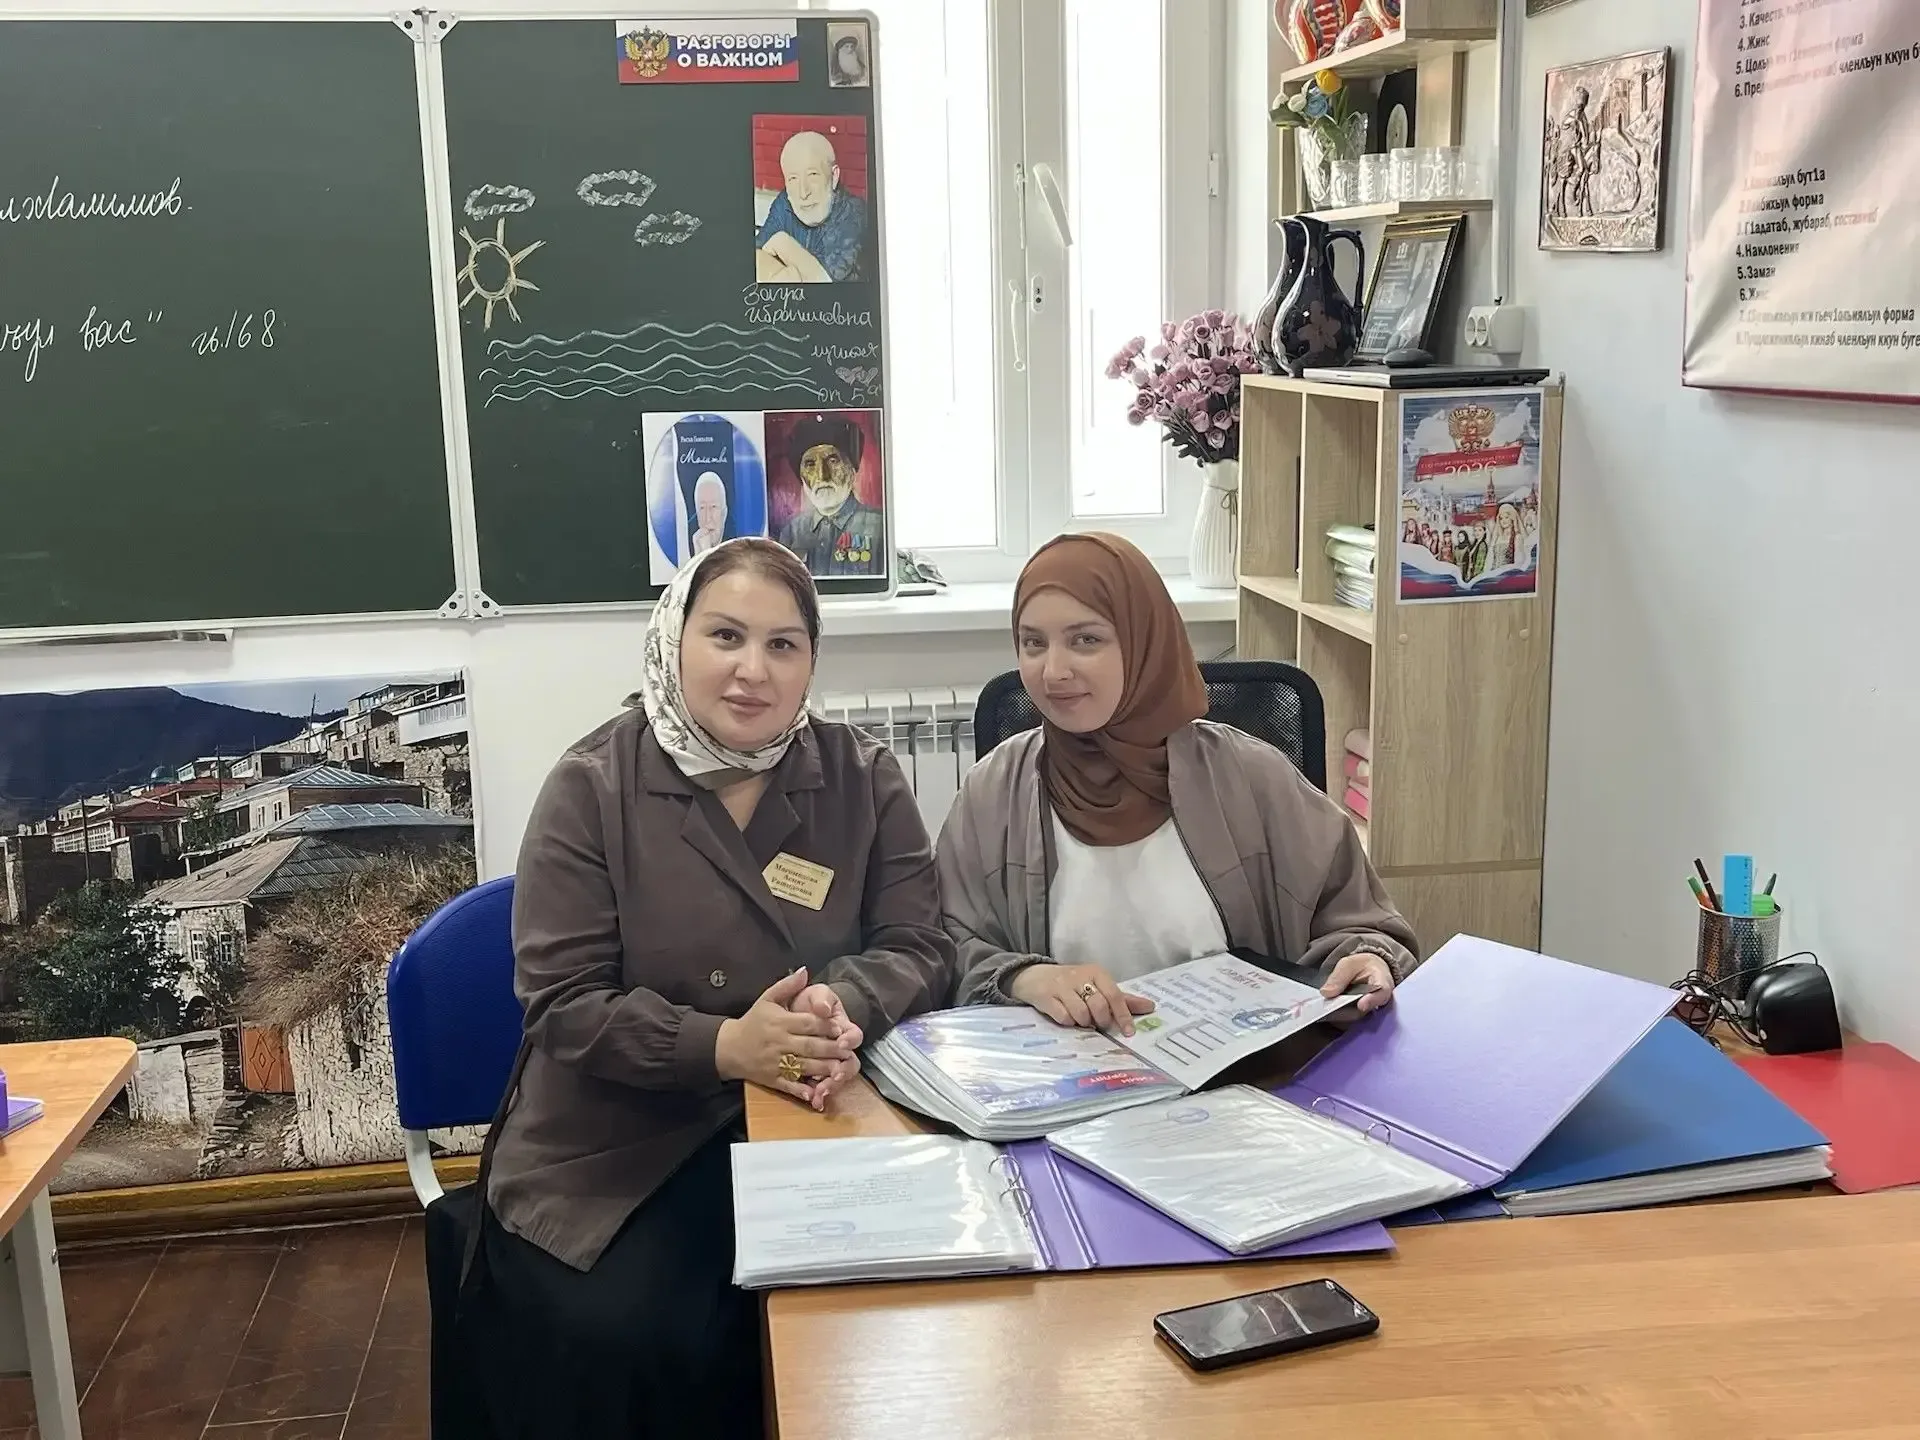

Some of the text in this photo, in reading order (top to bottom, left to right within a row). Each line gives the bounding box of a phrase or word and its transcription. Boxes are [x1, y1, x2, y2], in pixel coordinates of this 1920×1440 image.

[676, 33, 790, 51] РАЗГОВОРЫ
[677, 52, 783, 68] О ВАЖНОМ
[1792, 193, 1824, 210] форма
[1882, 306, 1915, 324] форма
[1444, 460, 1499, 481] 2026
